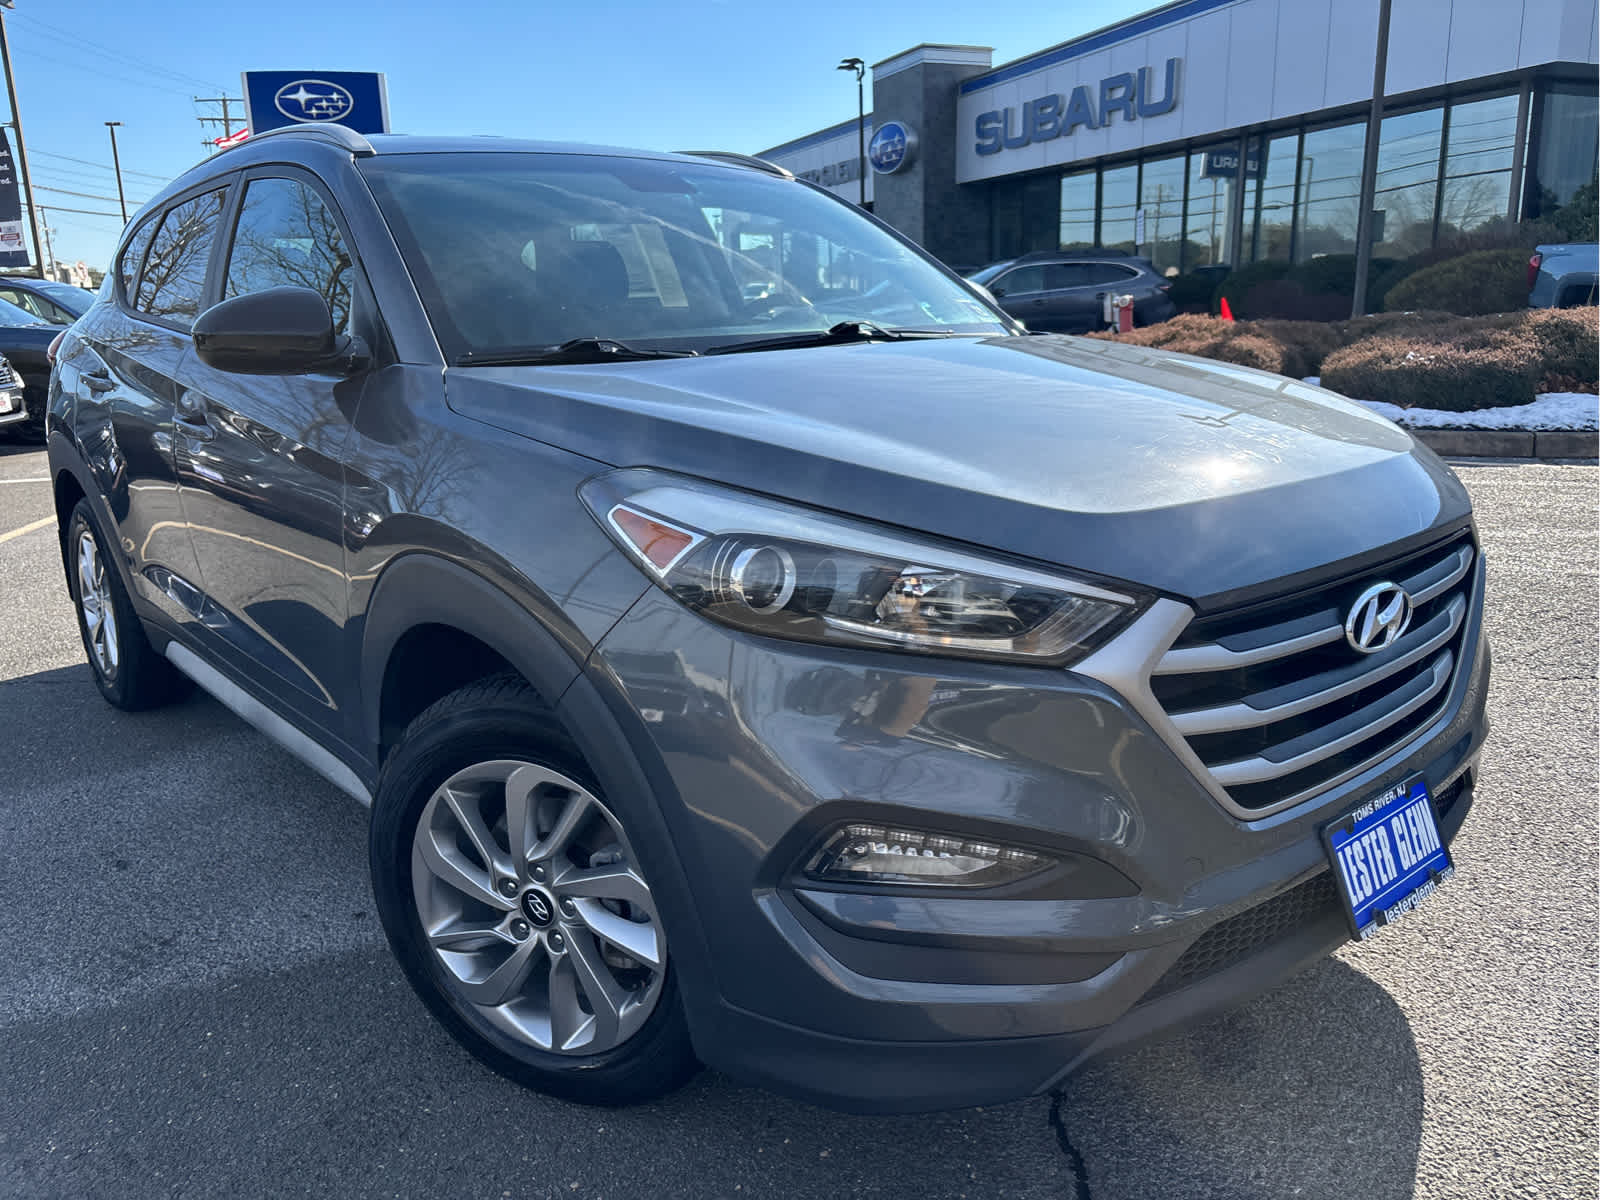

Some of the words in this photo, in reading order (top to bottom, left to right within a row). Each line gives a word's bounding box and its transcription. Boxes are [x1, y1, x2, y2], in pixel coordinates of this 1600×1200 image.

[975, 57, 1182, 157] SUBARU
[1338, 825, 1397, 907] LESTER
[1391, 798, 1441, 871] GLENN
[1352, 805, 1374, 823] TOMS
[1397, 784, 1406, 798] NJ
